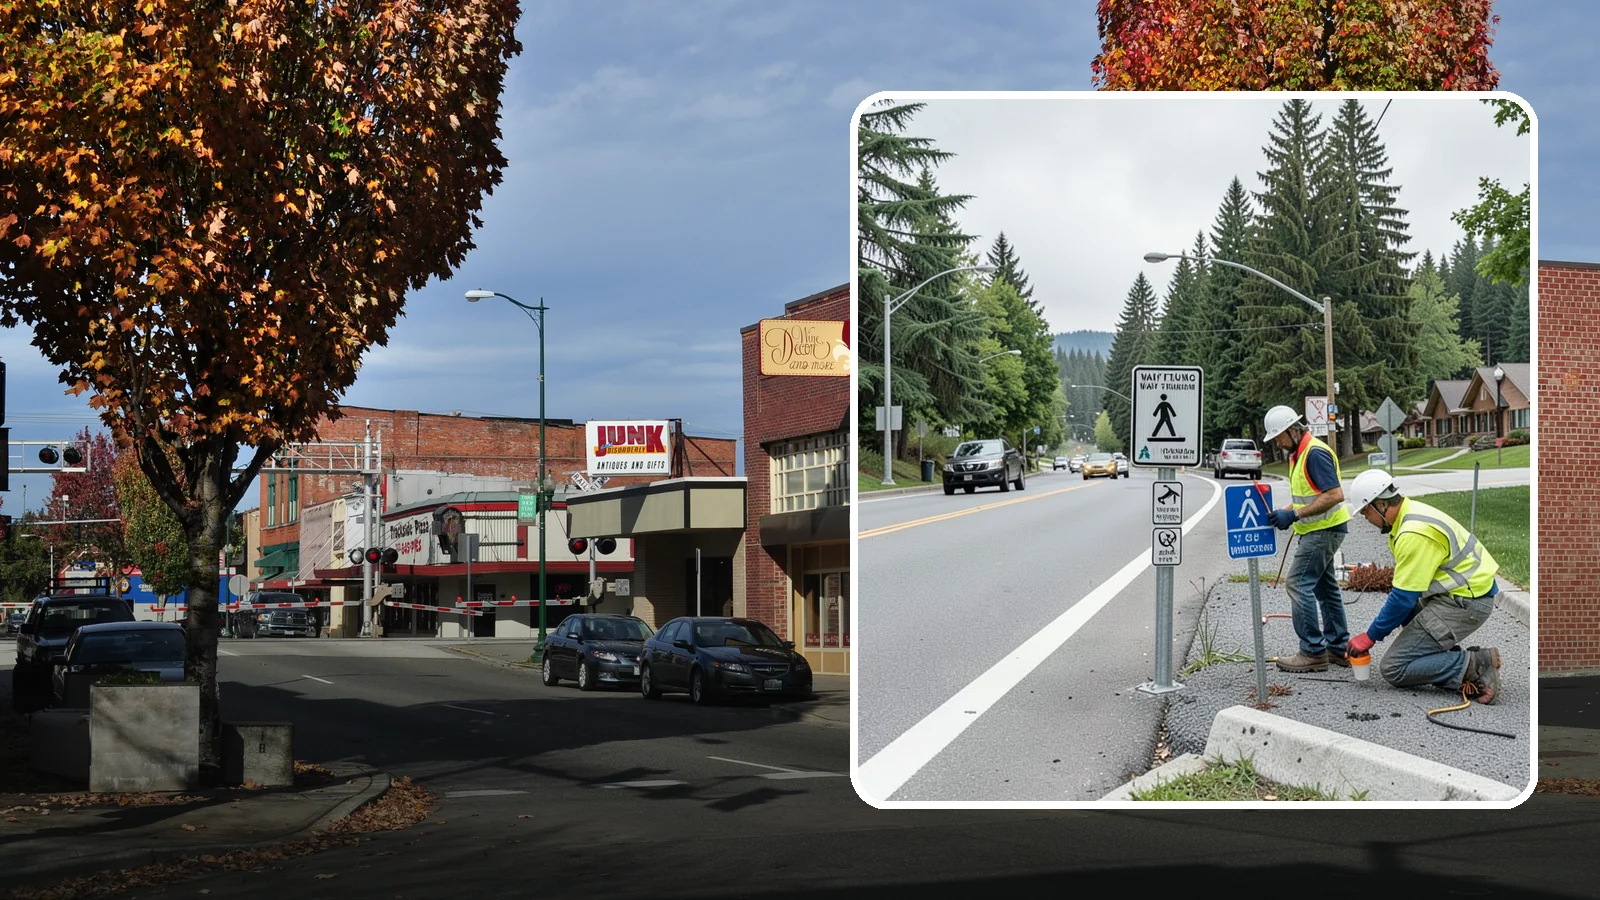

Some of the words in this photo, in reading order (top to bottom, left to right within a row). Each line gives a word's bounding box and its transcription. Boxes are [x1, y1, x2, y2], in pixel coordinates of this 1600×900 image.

[765, 327, 831, 366] Decor
[595, 425, 666, 457] JUNK
[607, 446, 646, 454] DISORDERLY
[597, 461, 628, 470] ANTIQUES
[631, 461, 644, 470] AND
[647, 461, 666, 470] GIFTS
[390, 524, 413, 540] Trackside
[414, 519, 429, 535] Pizza
